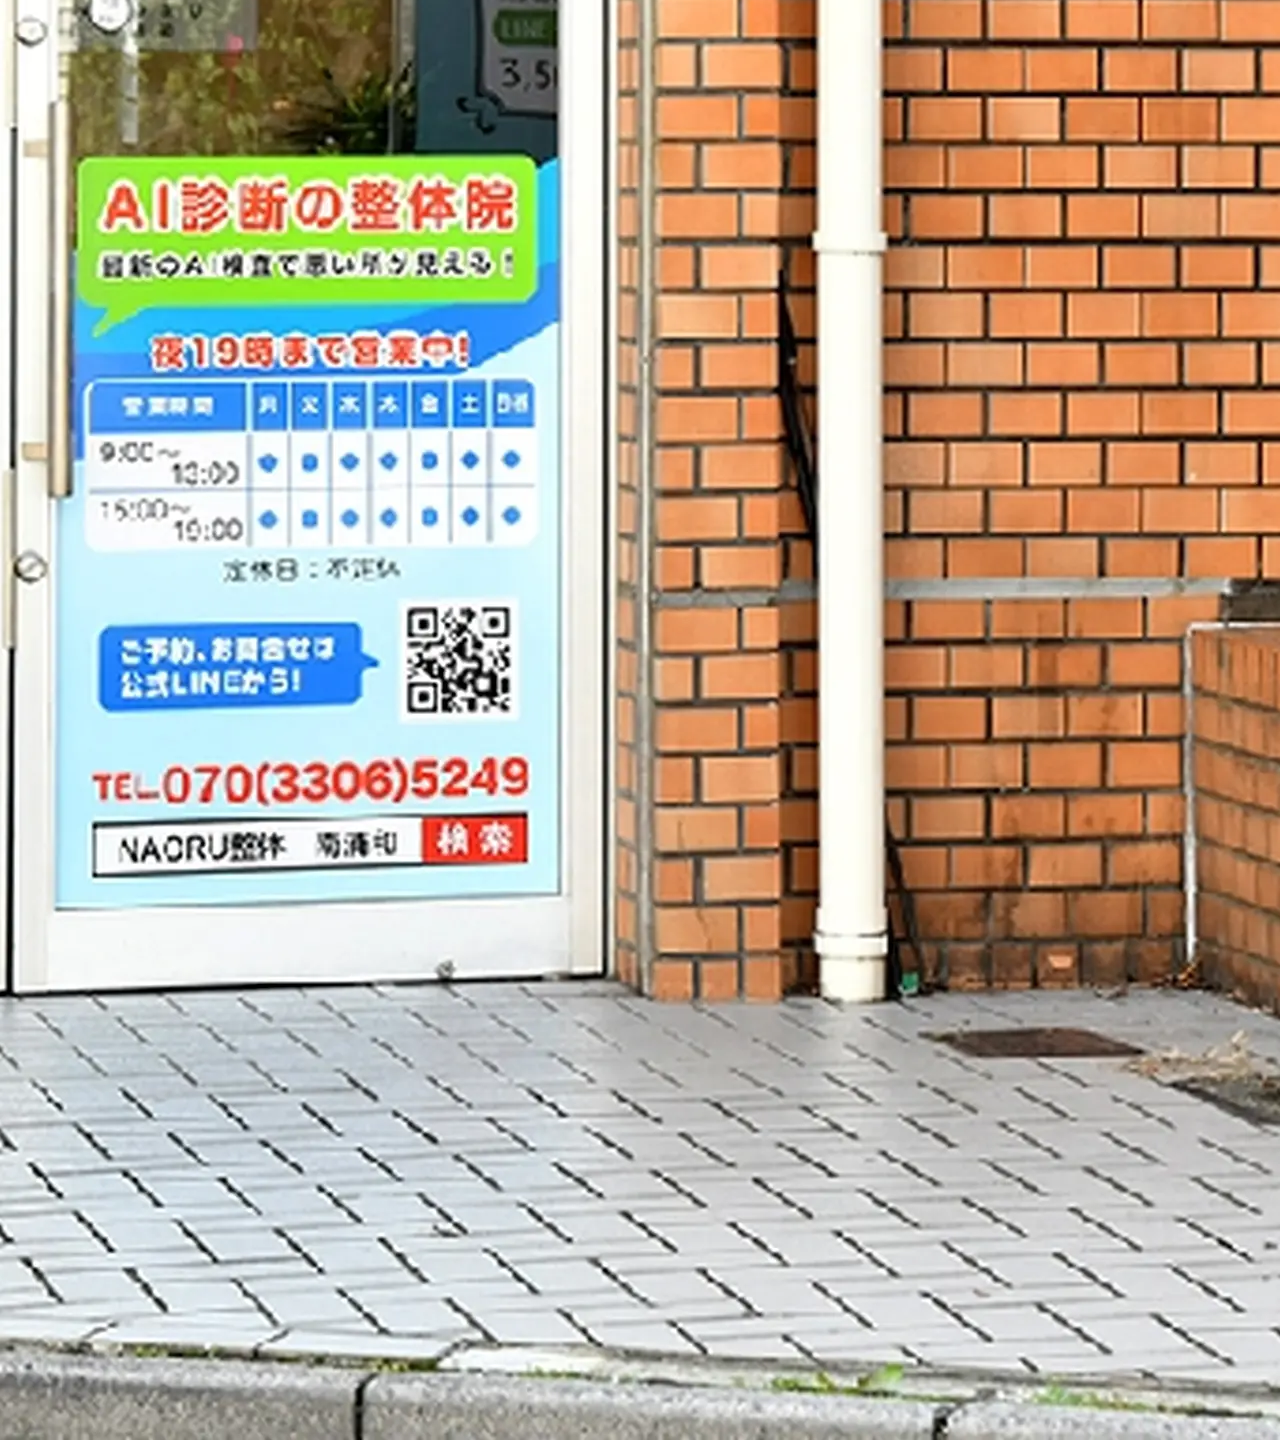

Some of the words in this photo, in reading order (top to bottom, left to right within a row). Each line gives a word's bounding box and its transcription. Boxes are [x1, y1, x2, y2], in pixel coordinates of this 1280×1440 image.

[104, 180, 515, 230] AI診断の整体院
[437, 821, 513, 856] 検索
